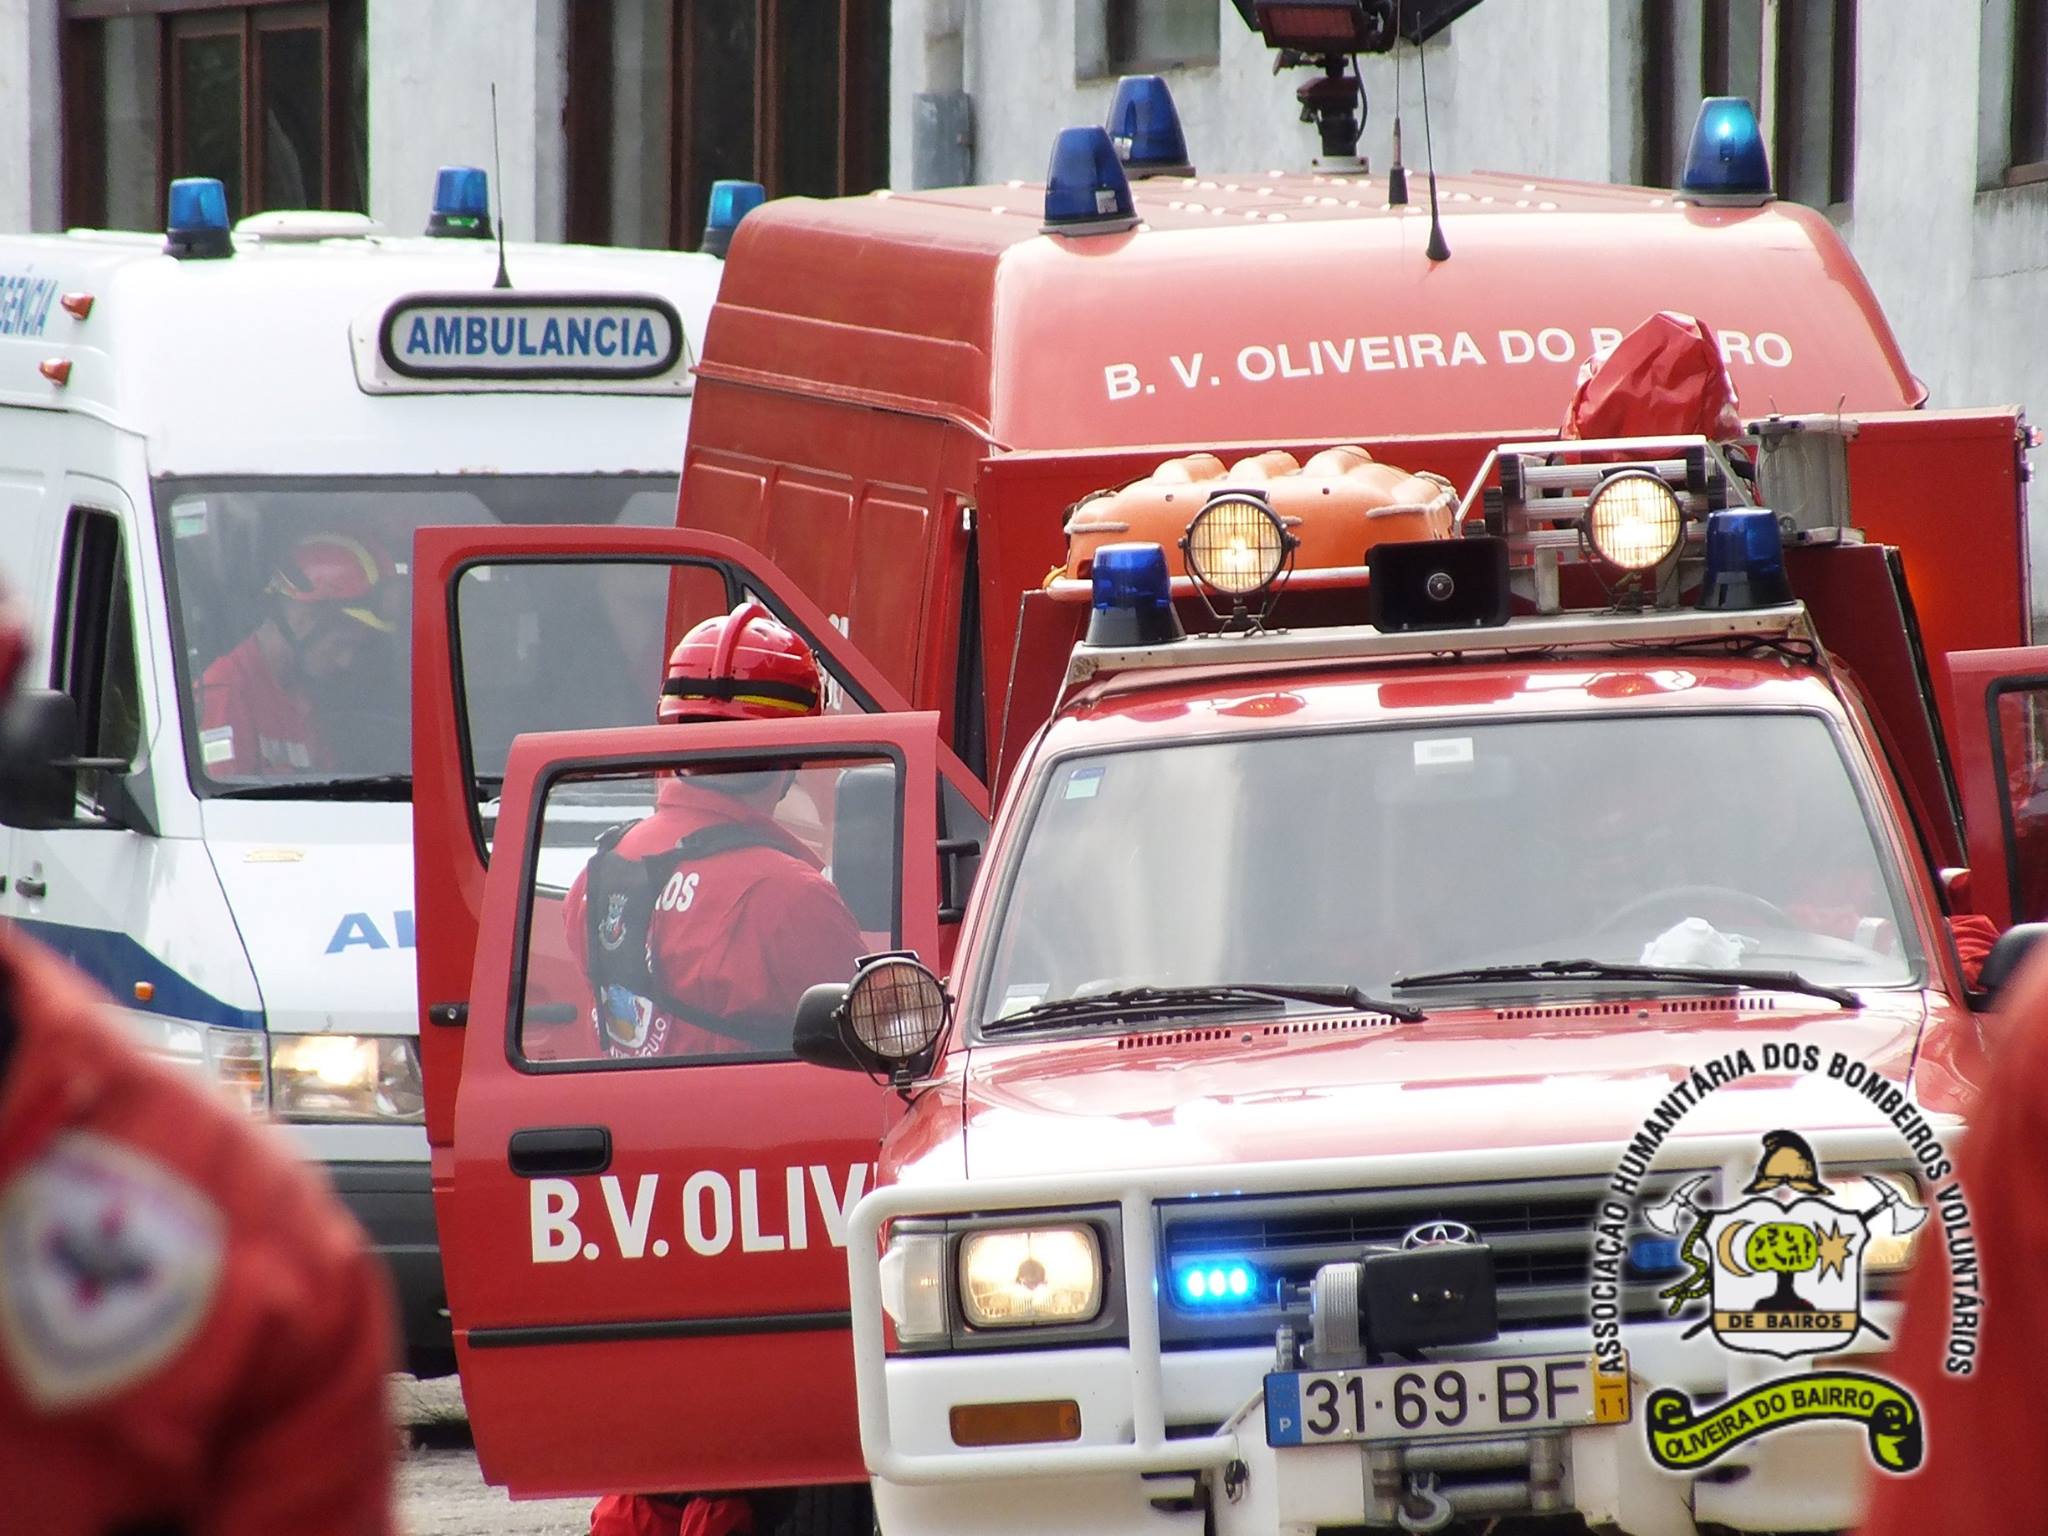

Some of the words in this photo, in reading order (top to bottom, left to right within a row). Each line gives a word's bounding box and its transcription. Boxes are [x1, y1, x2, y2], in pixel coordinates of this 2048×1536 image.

[406, 315, 658, 358] AMBULANCIA
[1105, 363, 1156, 402] B.
[1170, 352, 1221, 389] V.
[1236, 330, 1488, 382] OLIVEIRA
[1500, 327, 1576, 366] DO
[1592, 325, 1794, 370] BRO
[682, 1162, 879, 1257] OLIV
[1279, 1417, 1292, 1433] P
